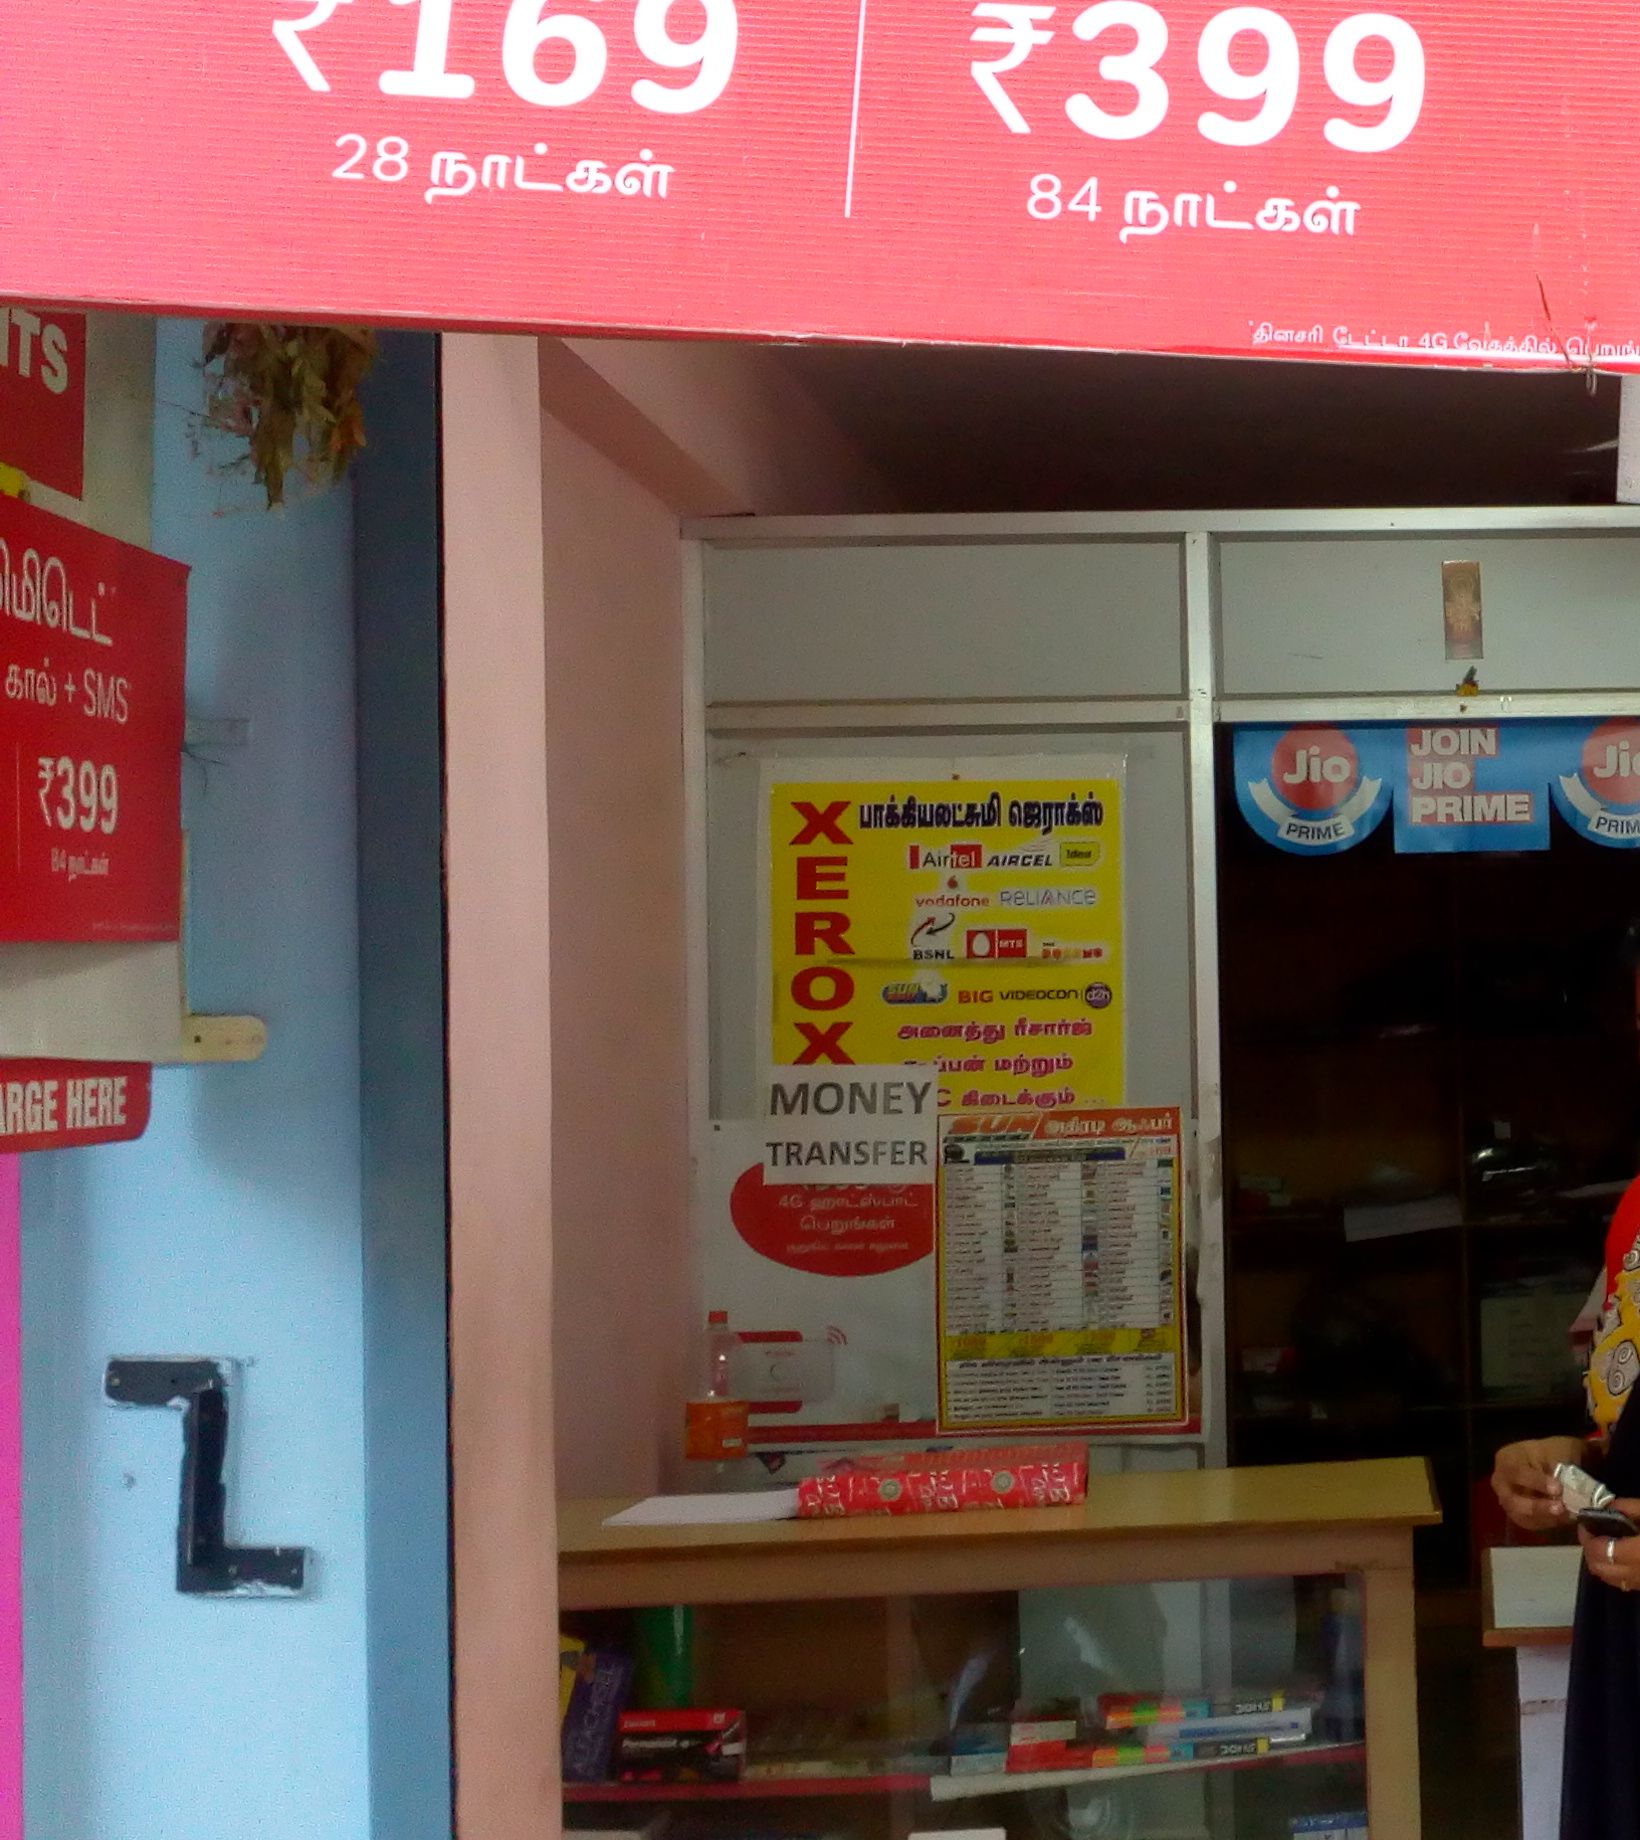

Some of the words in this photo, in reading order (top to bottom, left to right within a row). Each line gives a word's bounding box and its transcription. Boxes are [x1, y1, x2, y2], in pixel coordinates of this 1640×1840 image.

[970, 0, 1425, 152] ₹399
[331, 134, 408, 182] 28
[424, 143, 674, 204] நாட்கள்
[1027, 173, 1102, 221] 84
[1119, 180, 1361, 243] நாட்கள்
[0, 308, 68, 394] TS
[83, 668, 129, 724] SMS
[1411, 728, 1497, 757] JOIN
[1283, 745, 1351, 784] Jio
[1412, 762, 1471, 790] JIO
[38, 756, 118, 834] ₹399
[1411, 794, 1529, 823] PRIME
[1285, 822, 1345, 841] PRIME
[987, 855, 1052, 867] AIRCEL
[915, 895, 990, 908] vodafone
[914, 949, 954, 960] BSNL
[959, 990, 994, 1004] BIG
[66, 1076, 128, 1130] HERE
[770, 1081, 932, 1115] MONEY
[766, 1140, 928, 1167] TRANSFER
